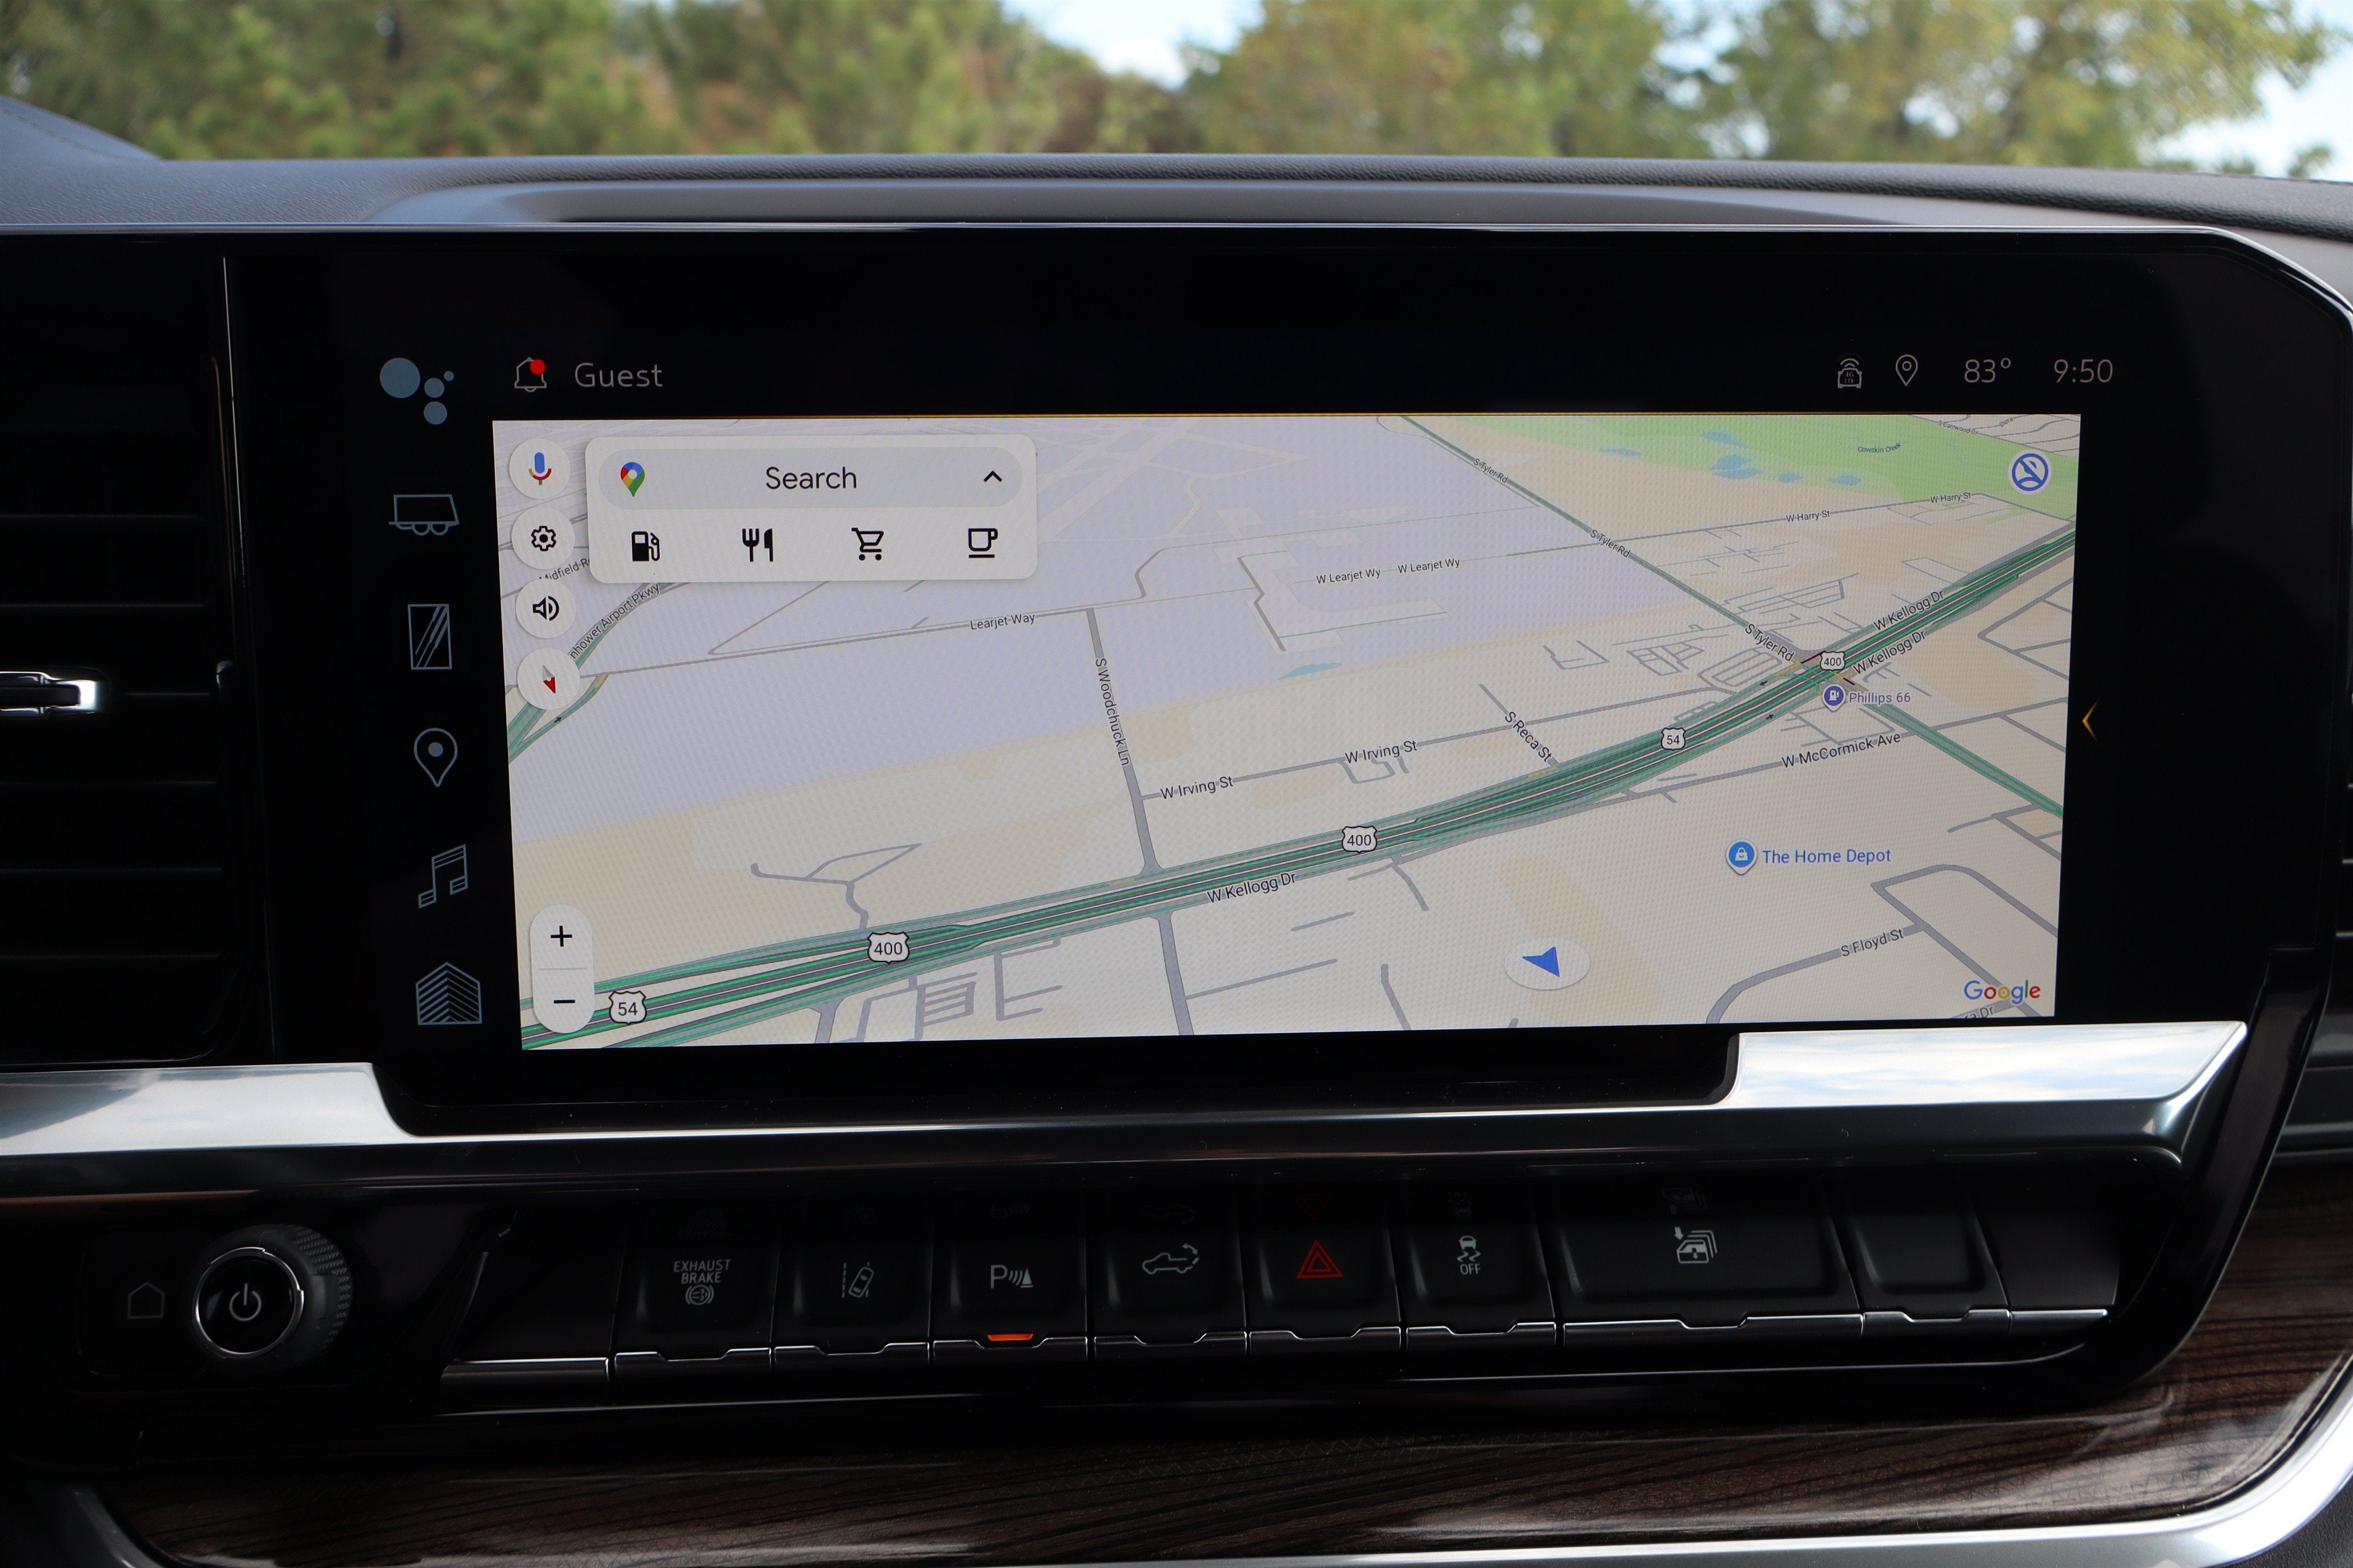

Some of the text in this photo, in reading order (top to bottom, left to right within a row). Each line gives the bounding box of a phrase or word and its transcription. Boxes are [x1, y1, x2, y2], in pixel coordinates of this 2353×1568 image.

[575, 363, 663, 387] Guest
[2054, 359, 2113, 383] 9:50
[1885, 443, 1901, 453] Creek
[766, 466, 857, 490] Search
[1481, 461, 1497, 476] Tyler
[1497, 473, 1509, 483] Rd
[1941, 493, 1961, 502] Harry
[1797, 512, 1819, 521] Harry
[1590, 530, 1630, 558] S Tyler Rd
[539, 562, 579, 580] idfield
[1316, 568, 1381, 584] W Learjet Wy
[1398, 558, 1460, 574] W Learjet Wy
[1874, 589, 1945, 631] W Kellogg Dr
[570, 584, 659, 661] nhower Airport Pkwy
[970, 613, 1035, 630] Learjet Way
[1745, 624, 1795, 662] S Tyler Rd
[1853, 631, 1926, 675] W Kellogg Dr
[1823, 657, 1841, 666] 400
[1849, 692, 1911, 705] Phillips 66
[1096, 658, 1130, 766] S Woodchuck Ln
[1505, 711, 1552, 762] S Reca St
[1667, 735, 1680, 745] 54
[1345, 741, 1418, 763] W Irving St
[1781, 733, 1901, 768] W McCormick Ave
[1161, 776, 1233, 800] W Irving St
[1347, 835, 1372, 847] 400
[1763, 849, 1891, 865] The Home Depot
[1208, 872, 1296, 903] W Kellogg Dr
[874, 940, 902, 956] 400
[1841, 929, 1904, 956] S Floyd St
[1964, 980, 2040, 1004] Google
[618, 1002, 638, 1016] 54
[673, 1260, 731, 1273] EXHAUST
[1460, 1264, 1480, 1275] OFF
[681, 1272, 722, 1284] BRAKE
